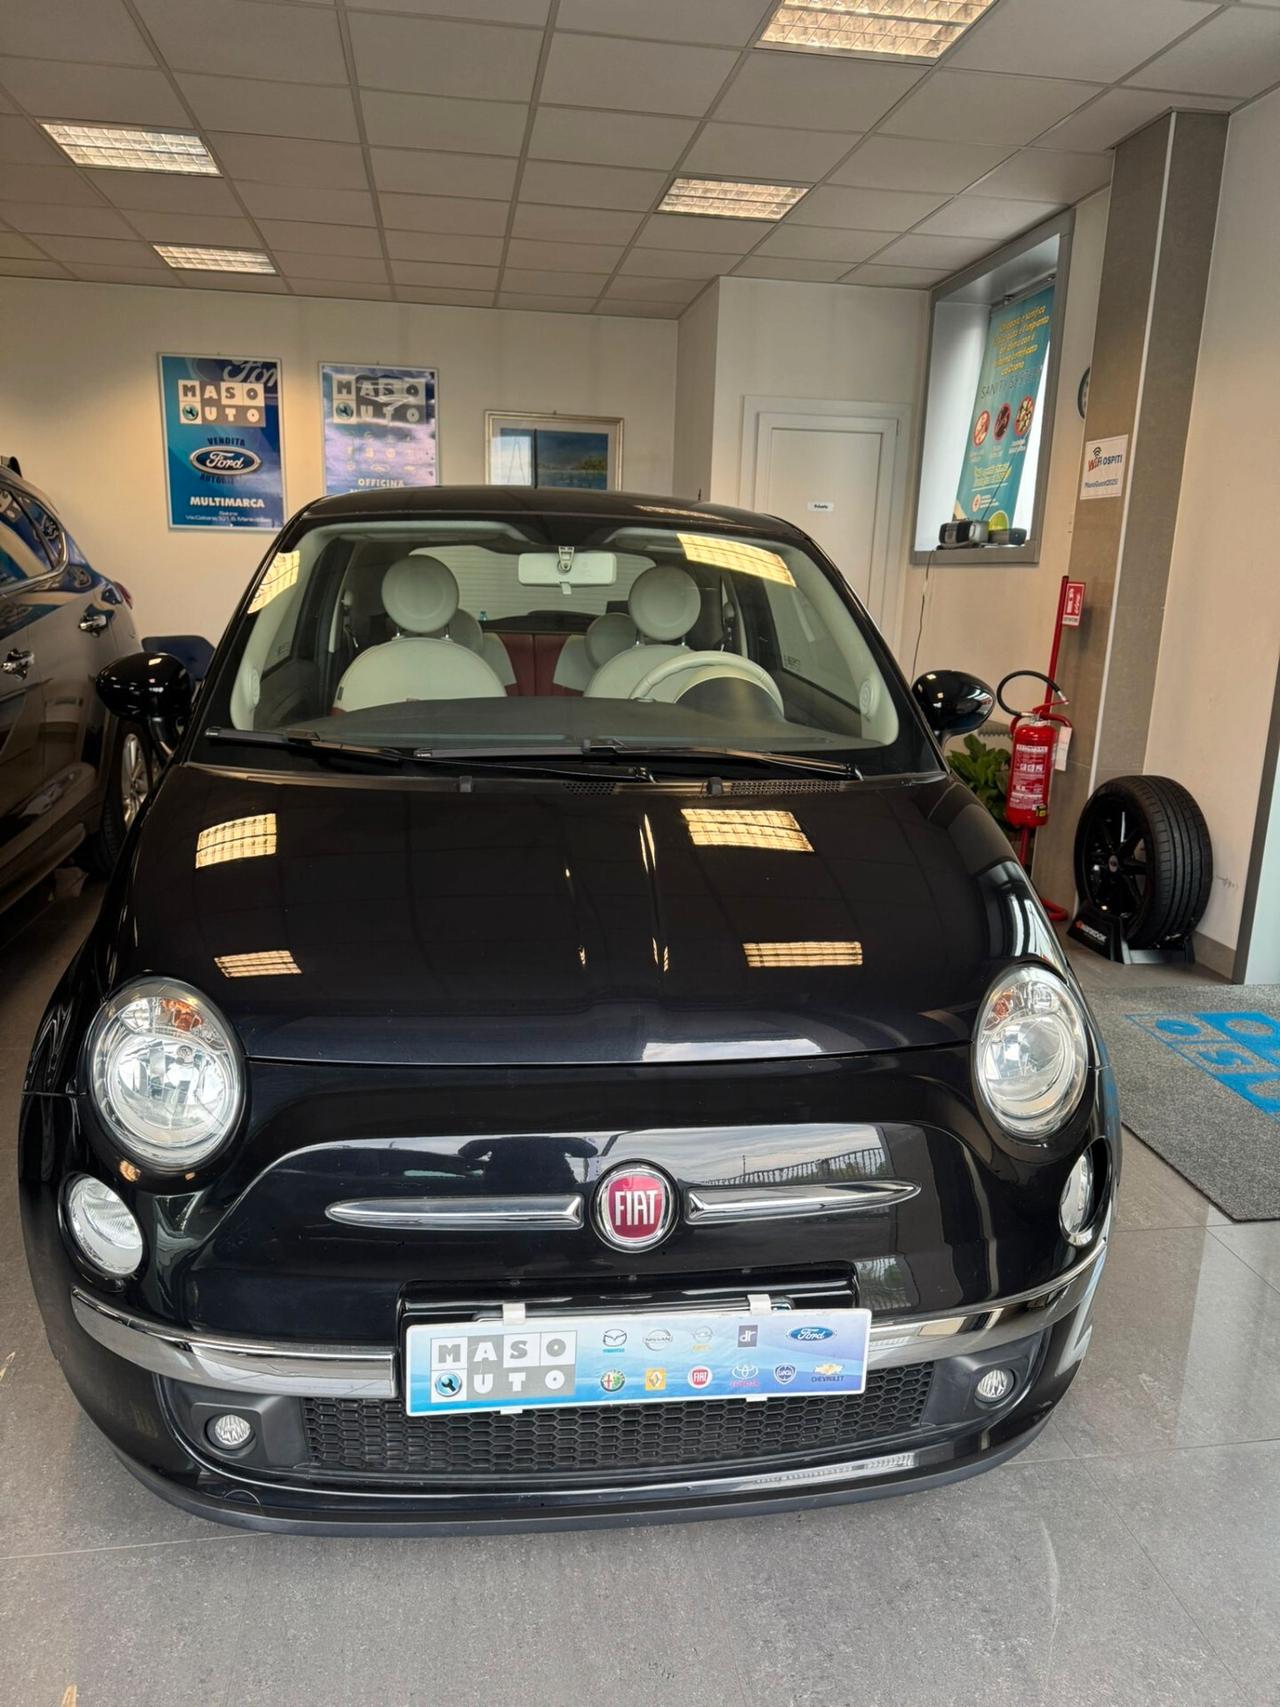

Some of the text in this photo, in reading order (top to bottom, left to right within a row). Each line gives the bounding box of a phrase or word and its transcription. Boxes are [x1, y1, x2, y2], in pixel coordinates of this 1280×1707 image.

[182, 384, 259, 400] MASO
[336, 380, 419, 397] MASO
[207, 437, 245, 447] VENDITA
[206, 451, 243, 469] Ford
[357, 478, 405, 488] OFFICINA
[190, 496, 265, 508] MULTIMARCA
[614, 1190, 658, 1226] FIAT
[739, 1330, 756, 1342] dr
[797, 1329, 825, 1340] Ford
[438, 1338, 566, 1364] MASO
[693, 1371, 708, 1383] FIAT
